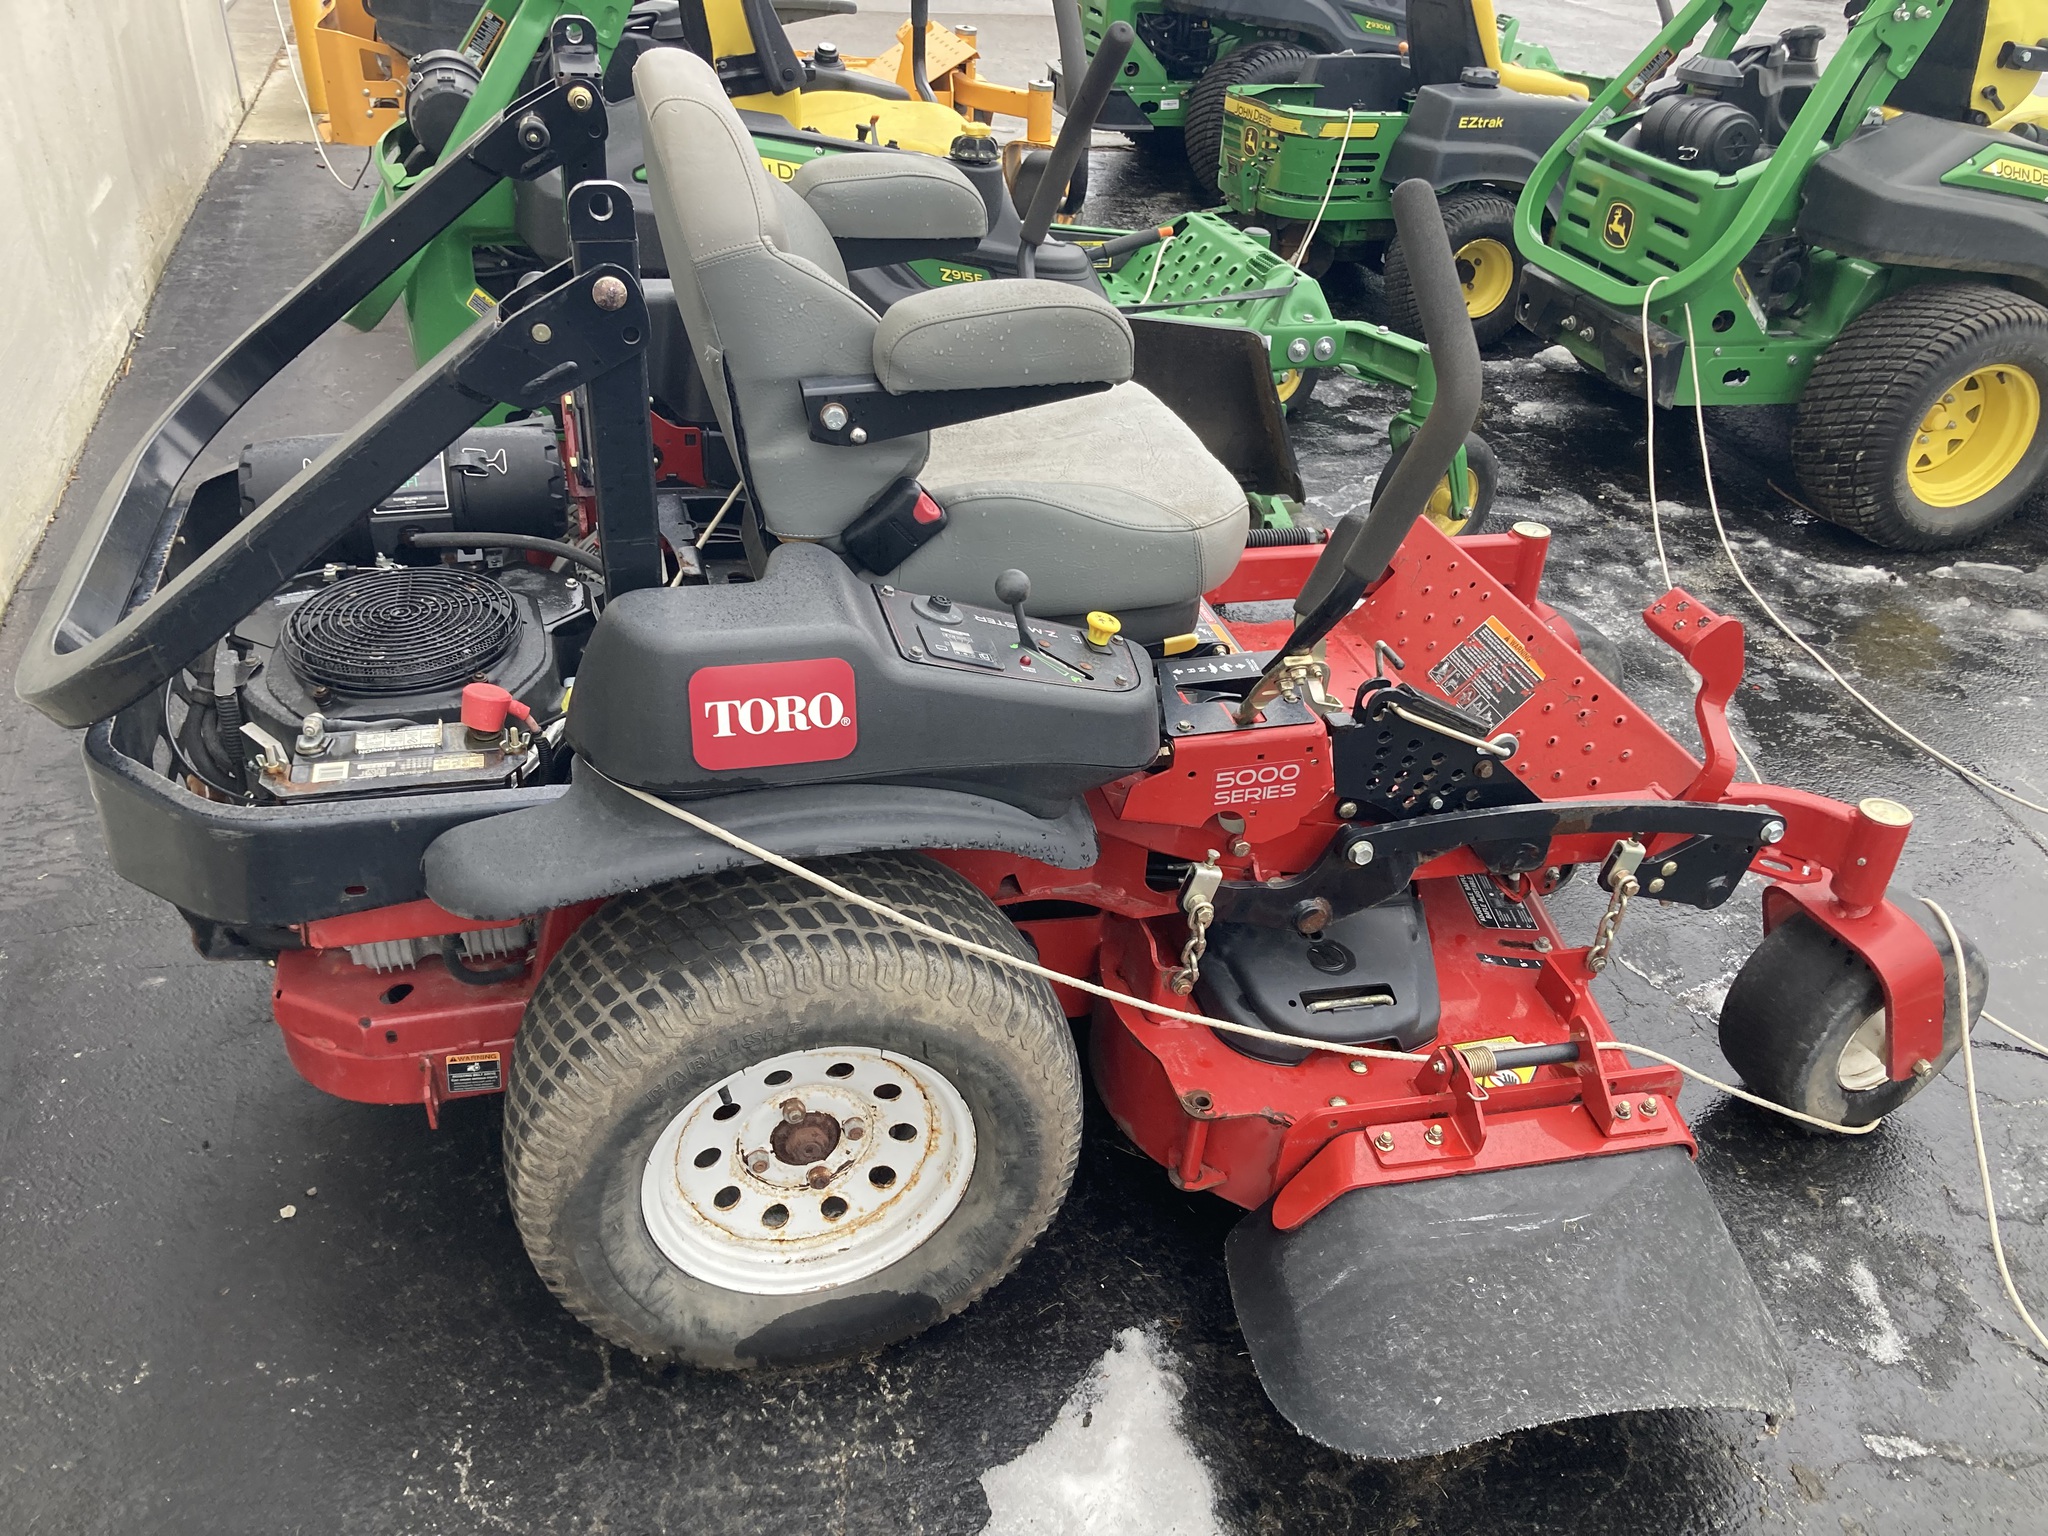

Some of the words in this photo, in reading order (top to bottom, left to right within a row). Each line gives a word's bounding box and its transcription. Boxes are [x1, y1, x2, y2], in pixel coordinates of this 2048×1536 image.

[1234, 103, 1254, 120] JOHN
[1458, 116, 1504, 129] EZtrak
[1997, 161, 2030, 180] JOHN
[974, 614, 1043, 635] MSTER
[1215, 764, 1300, 789] 5000
[1213, 783, 1297, 806] SERIES
[457, 1053, 497, 1062] WARNING
